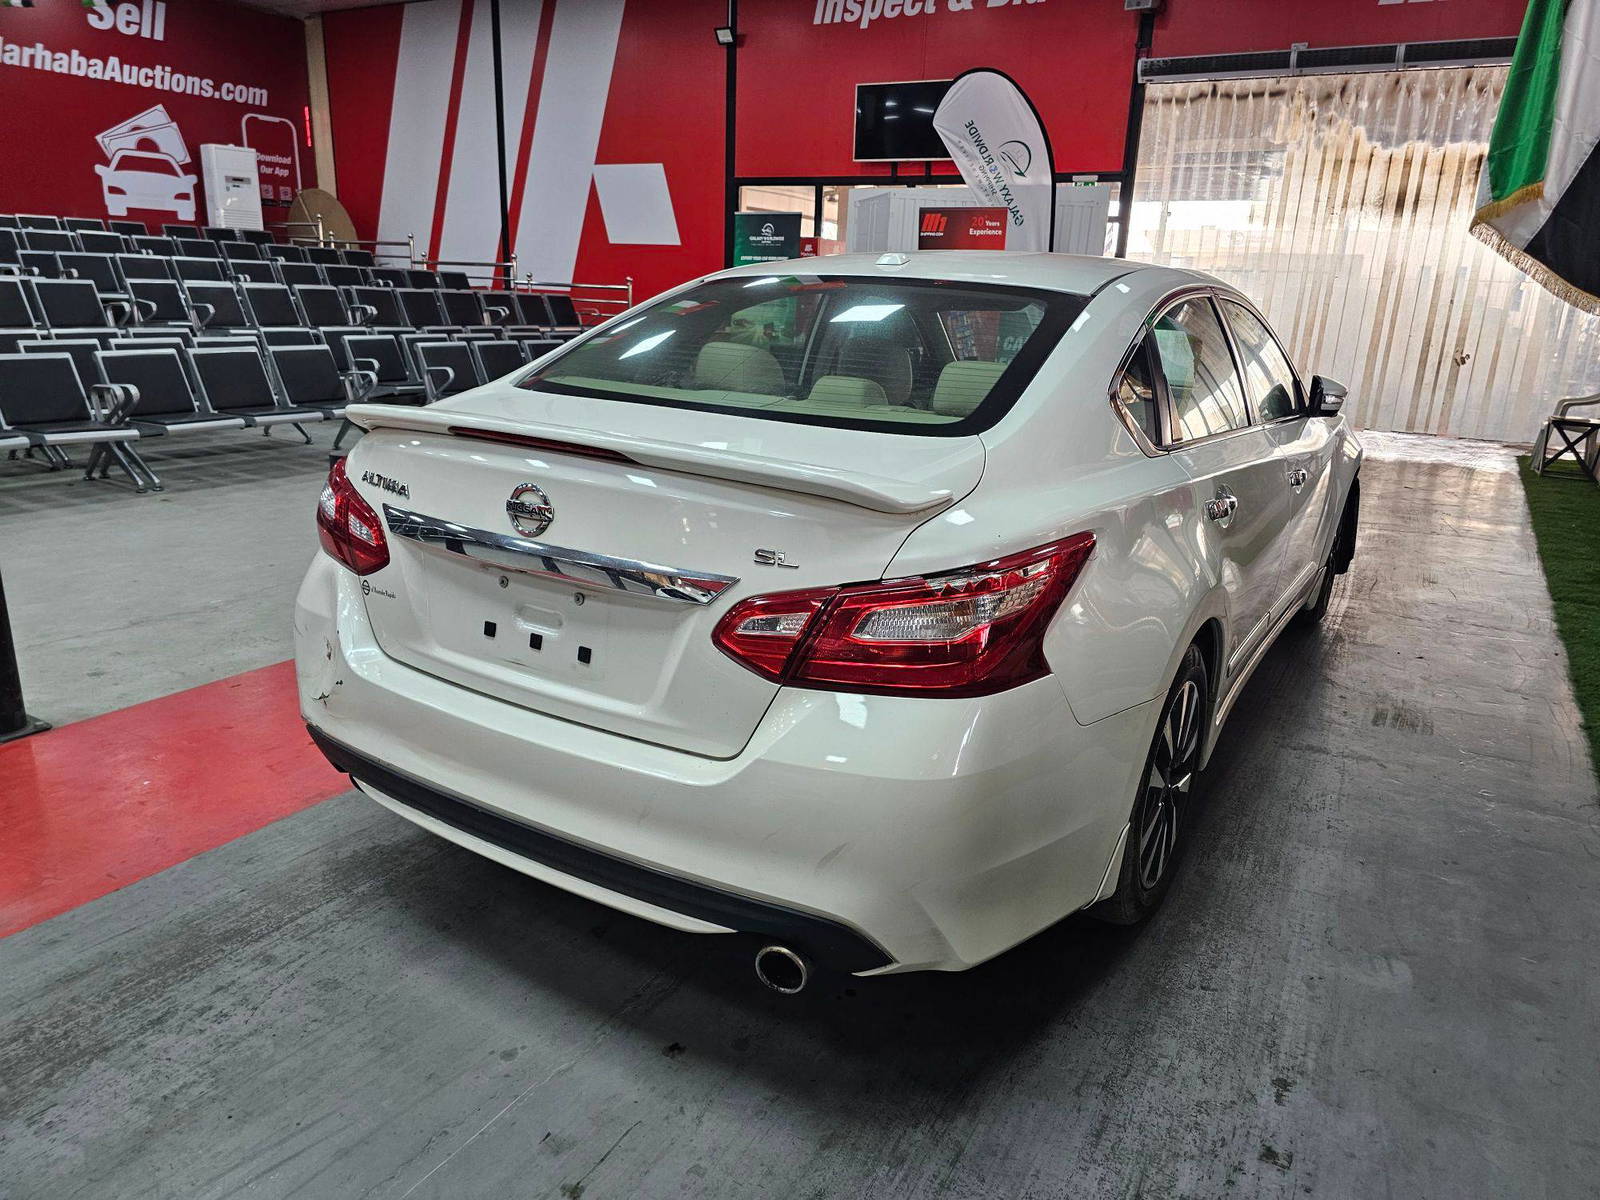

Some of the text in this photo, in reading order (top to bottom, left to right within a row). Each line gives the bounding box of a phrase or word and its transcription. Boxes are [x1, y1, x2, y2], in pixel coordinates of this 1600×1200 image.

[87, 0, 166, 41] Sell
[0, 36, 268, 107] arhabaAuctions.com
[969, 228, 1003, 236] Experience
[754, 549, 799, 569] SL
